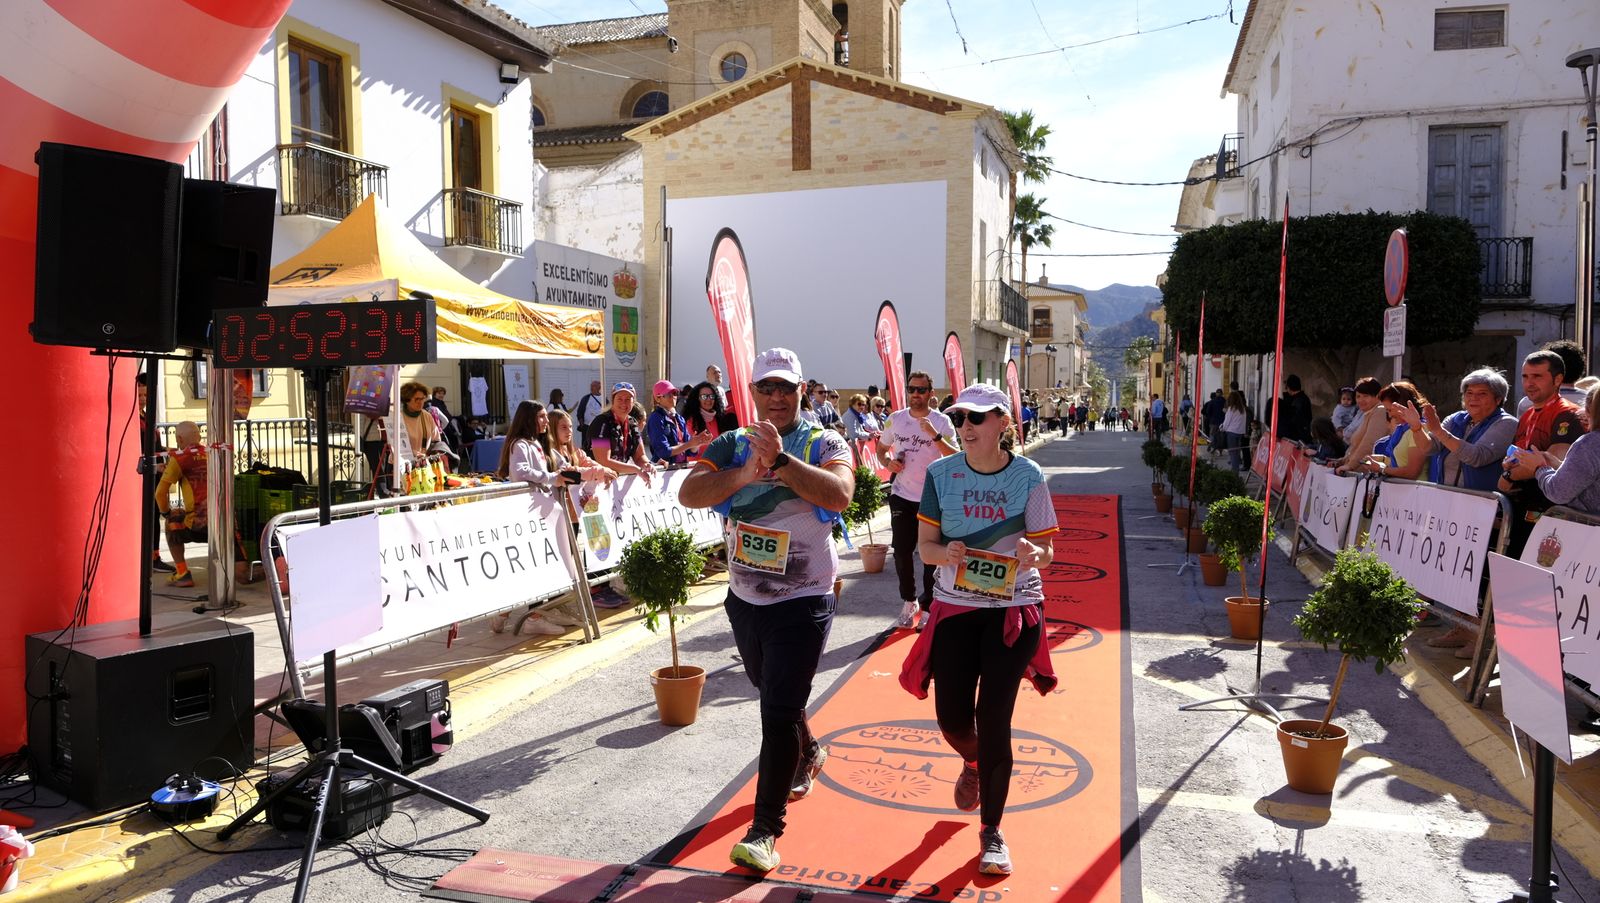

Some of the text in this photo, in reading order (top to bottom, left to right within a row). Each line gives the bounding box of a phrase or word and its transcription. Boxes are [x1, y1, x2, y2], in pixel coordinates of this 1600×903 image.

[543, 262, 608, 288] EXCELENTÍSIMO
[546, 287, 607, 309] AYUNTAMIENTO
[220, 308, 422, 362] 02:52:34
[963, 490, 1008, 505] PURA
[963, 505, 1006, 523] VIDA
[380, 518, 548, 565] YUNTAMIENTO DE
[742, 533, 778, 553] 636
[1465, 525, 1479, 543] DE
[967, 559, 1007, 580] 420
[879, 726, 941, 736] antoria
[776, 864, 1002, 903] de Cantoria
